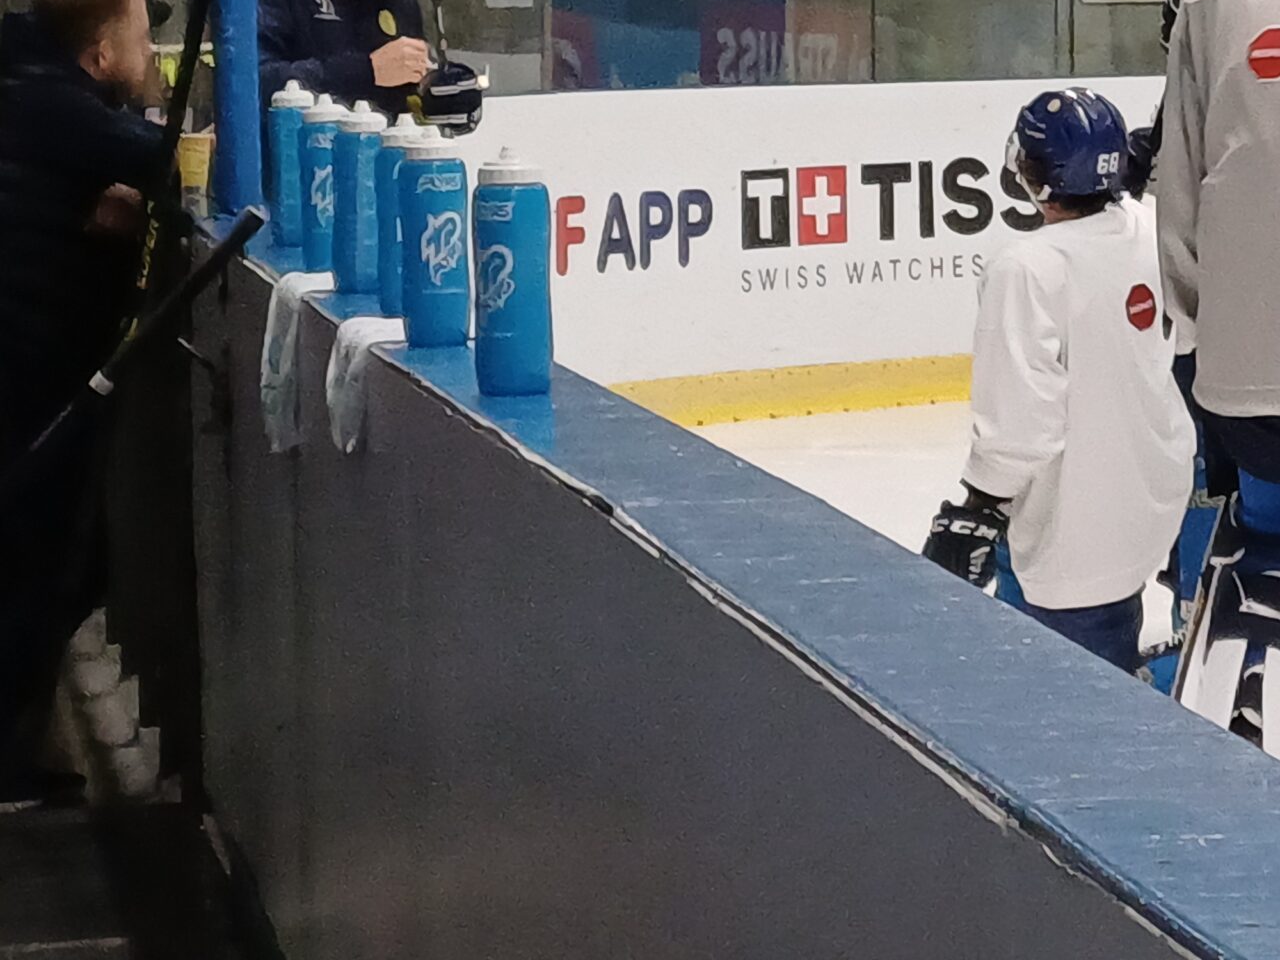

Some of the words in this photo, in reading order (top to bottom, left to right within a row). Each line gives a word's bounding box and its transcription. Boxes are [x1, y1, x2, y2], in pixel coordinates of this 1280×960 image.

[861, 157, 1045, 240] TISS
[741, 264, 827, 293] SWISS
[846, 253, 984, 285] WATCHES
